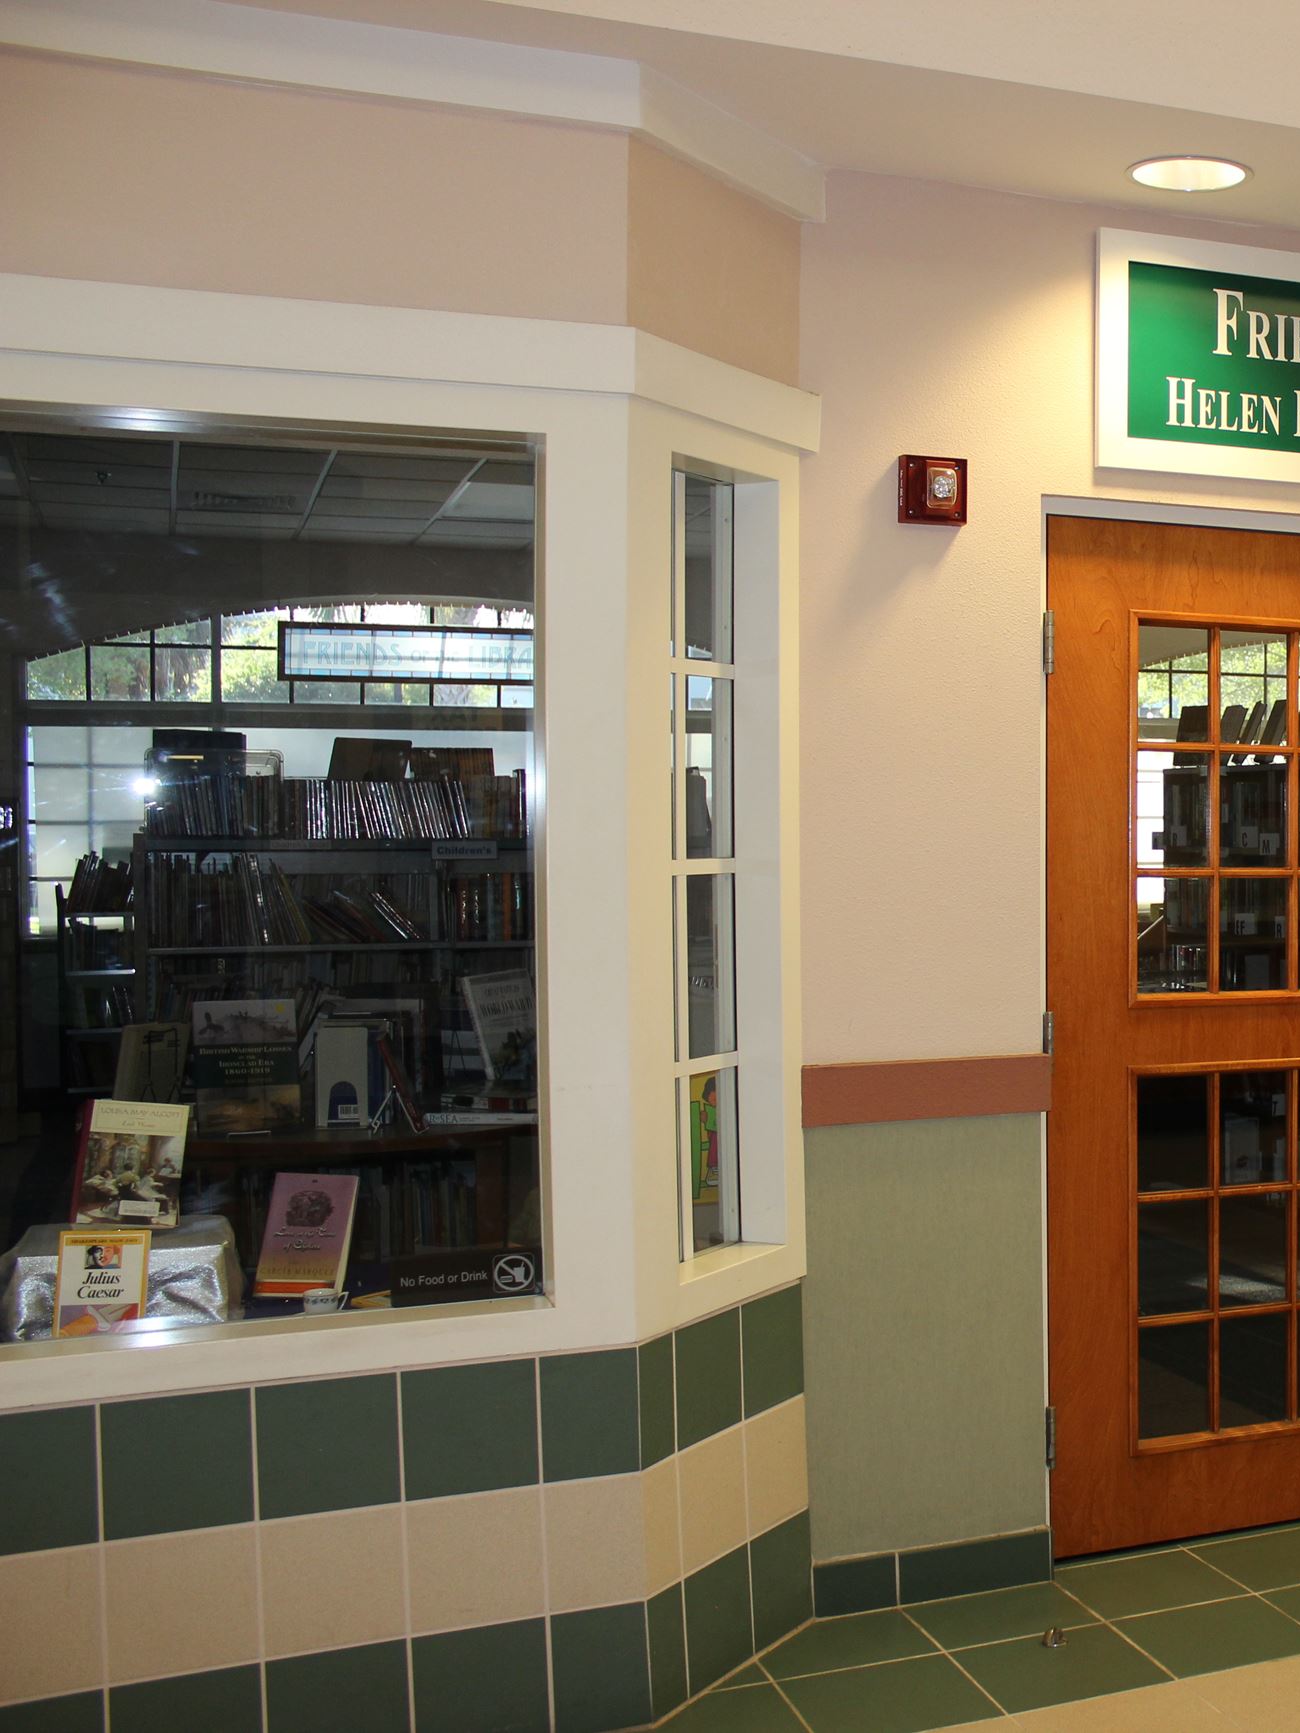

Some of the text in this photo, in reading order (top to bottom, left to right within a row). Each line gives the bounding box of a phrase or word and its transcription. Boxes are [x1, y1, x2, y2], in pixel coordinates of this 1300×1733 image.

[1165, 376, 1282, 436] HELEN
[303, 640, 402, 667] FRIENDS
[436, 845, 492, 856] Children's
[1262, 839, 1271, 854] M
[82, 1271, 122, 1285] Julius
[400, 1269, 489, 1288] No Food or Drink
[77, 1285, 125, 1299] Caesar
